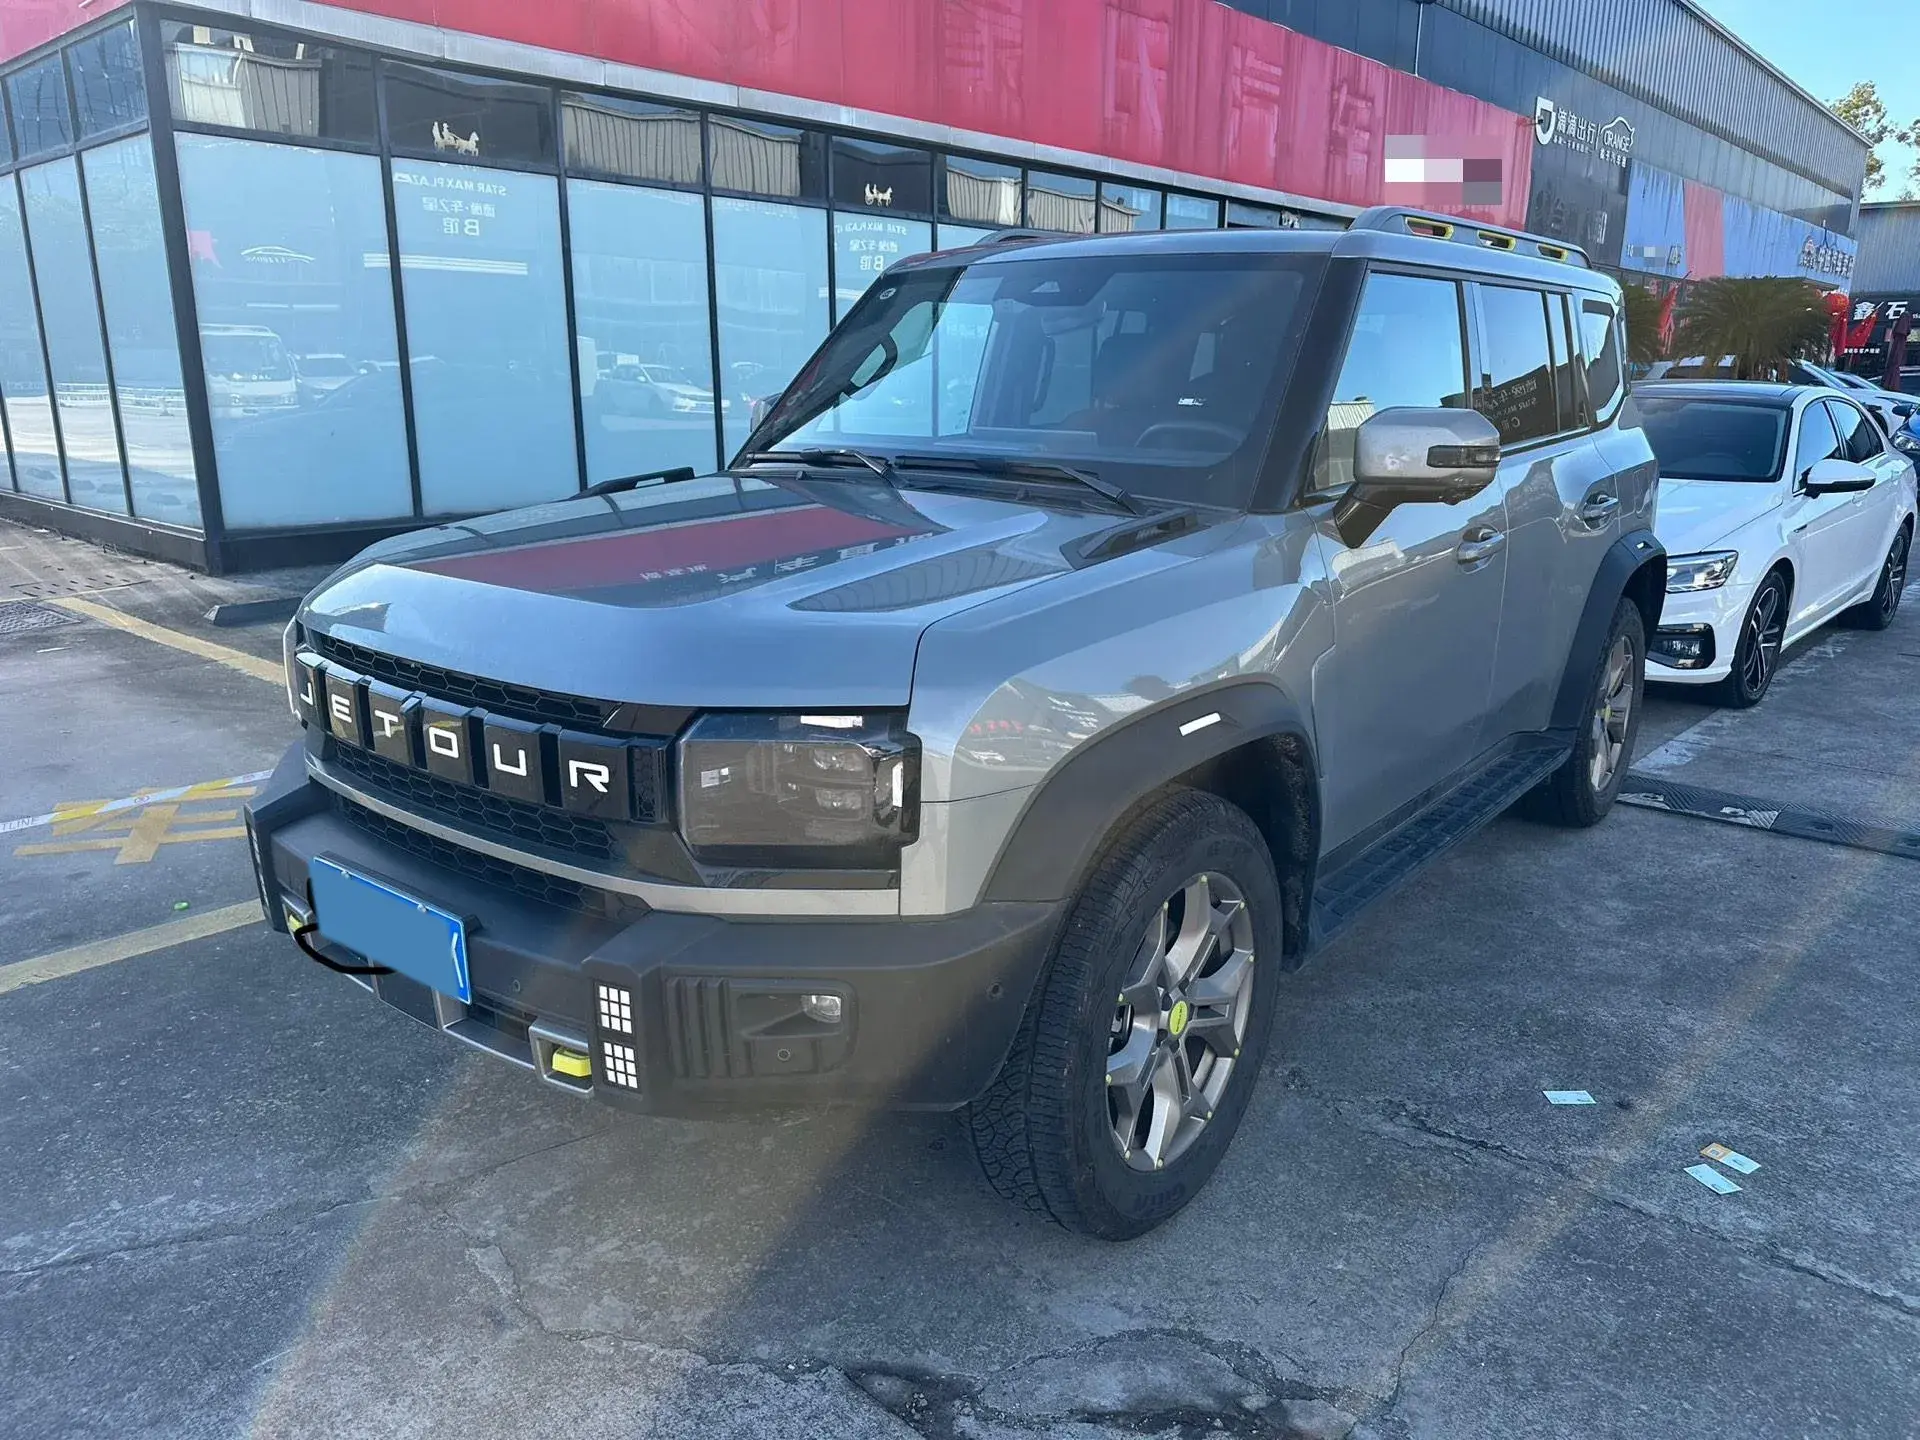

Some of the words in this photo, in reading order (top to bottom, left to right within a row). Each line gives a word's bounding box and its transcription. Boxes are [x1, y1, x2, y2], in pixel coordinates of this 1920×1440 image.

[1556, 107, 1596, 144] 滴滴出行
[1603, 130, 1630, 152] ORANGE
[298, 680, 611, 794] JETOUR
